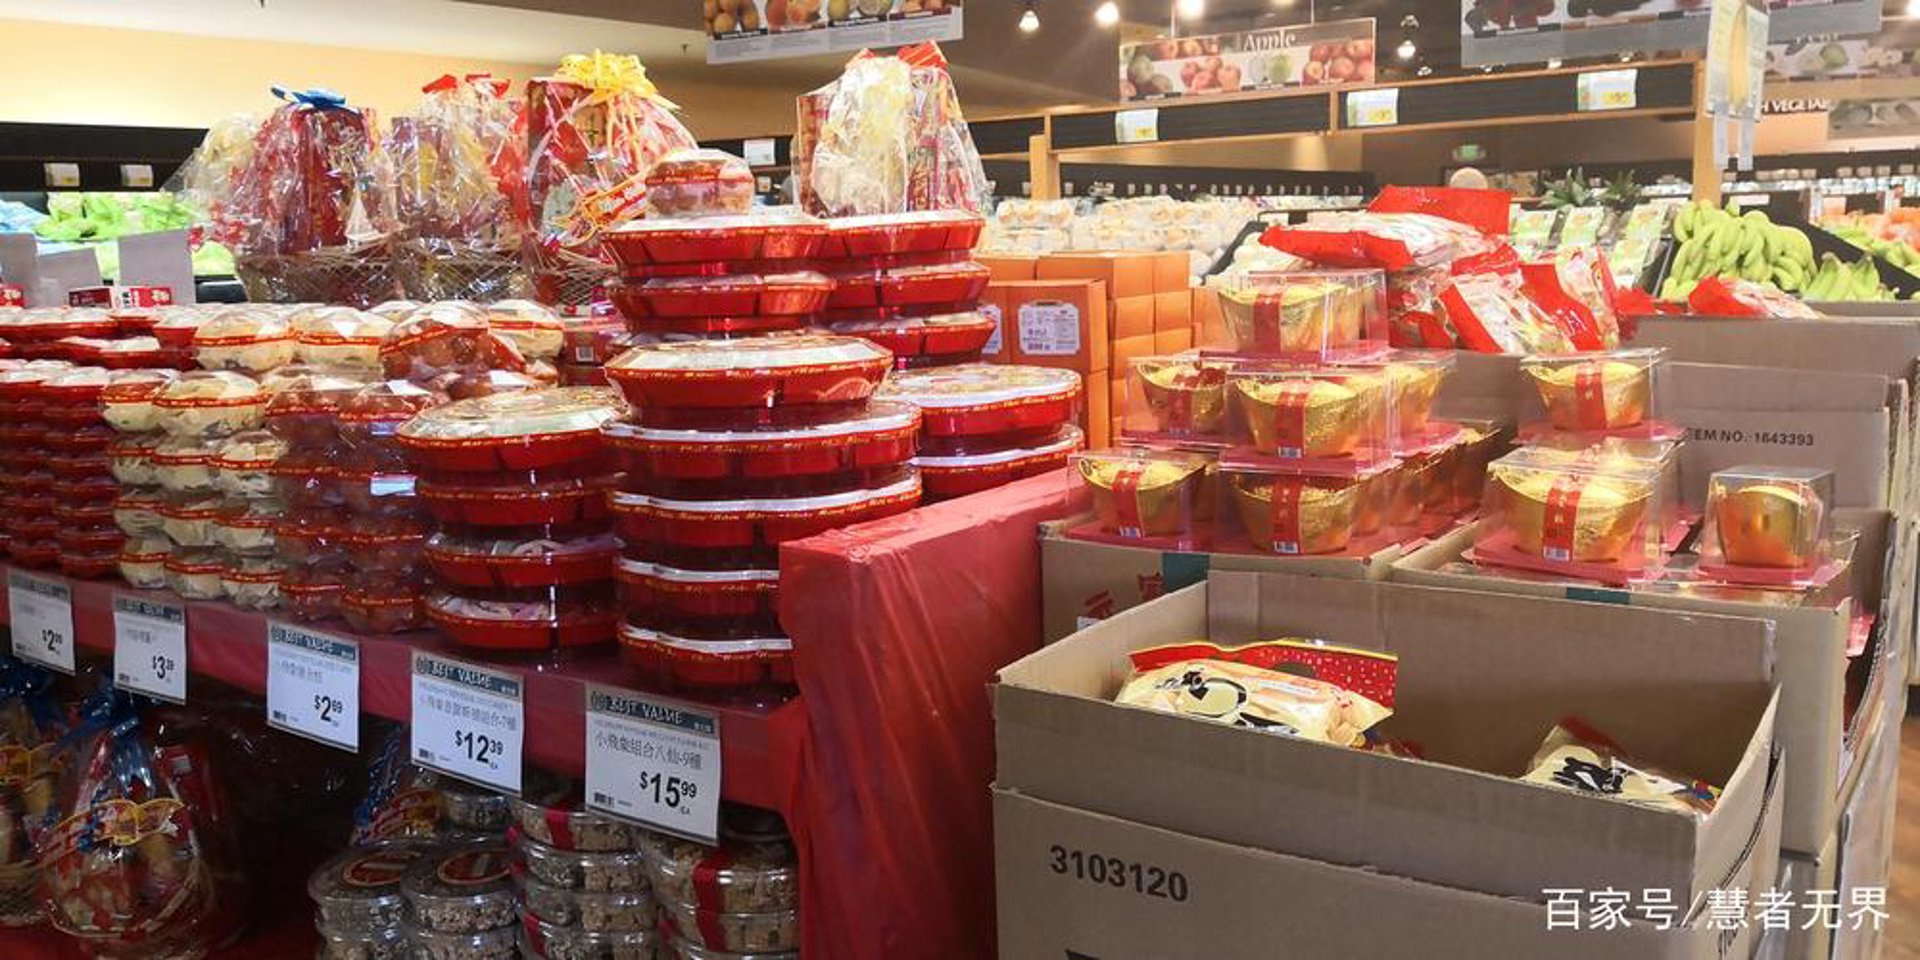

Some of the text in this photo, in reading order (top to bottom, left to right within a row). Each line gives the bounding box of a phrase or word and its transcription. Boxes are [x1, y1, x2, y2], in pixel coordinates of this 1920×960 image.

[1244, 32, 1296, 53] Apple
[1685, 427, 1717, 441] TEM
[1050, 844, 1189, 902] 3103120
